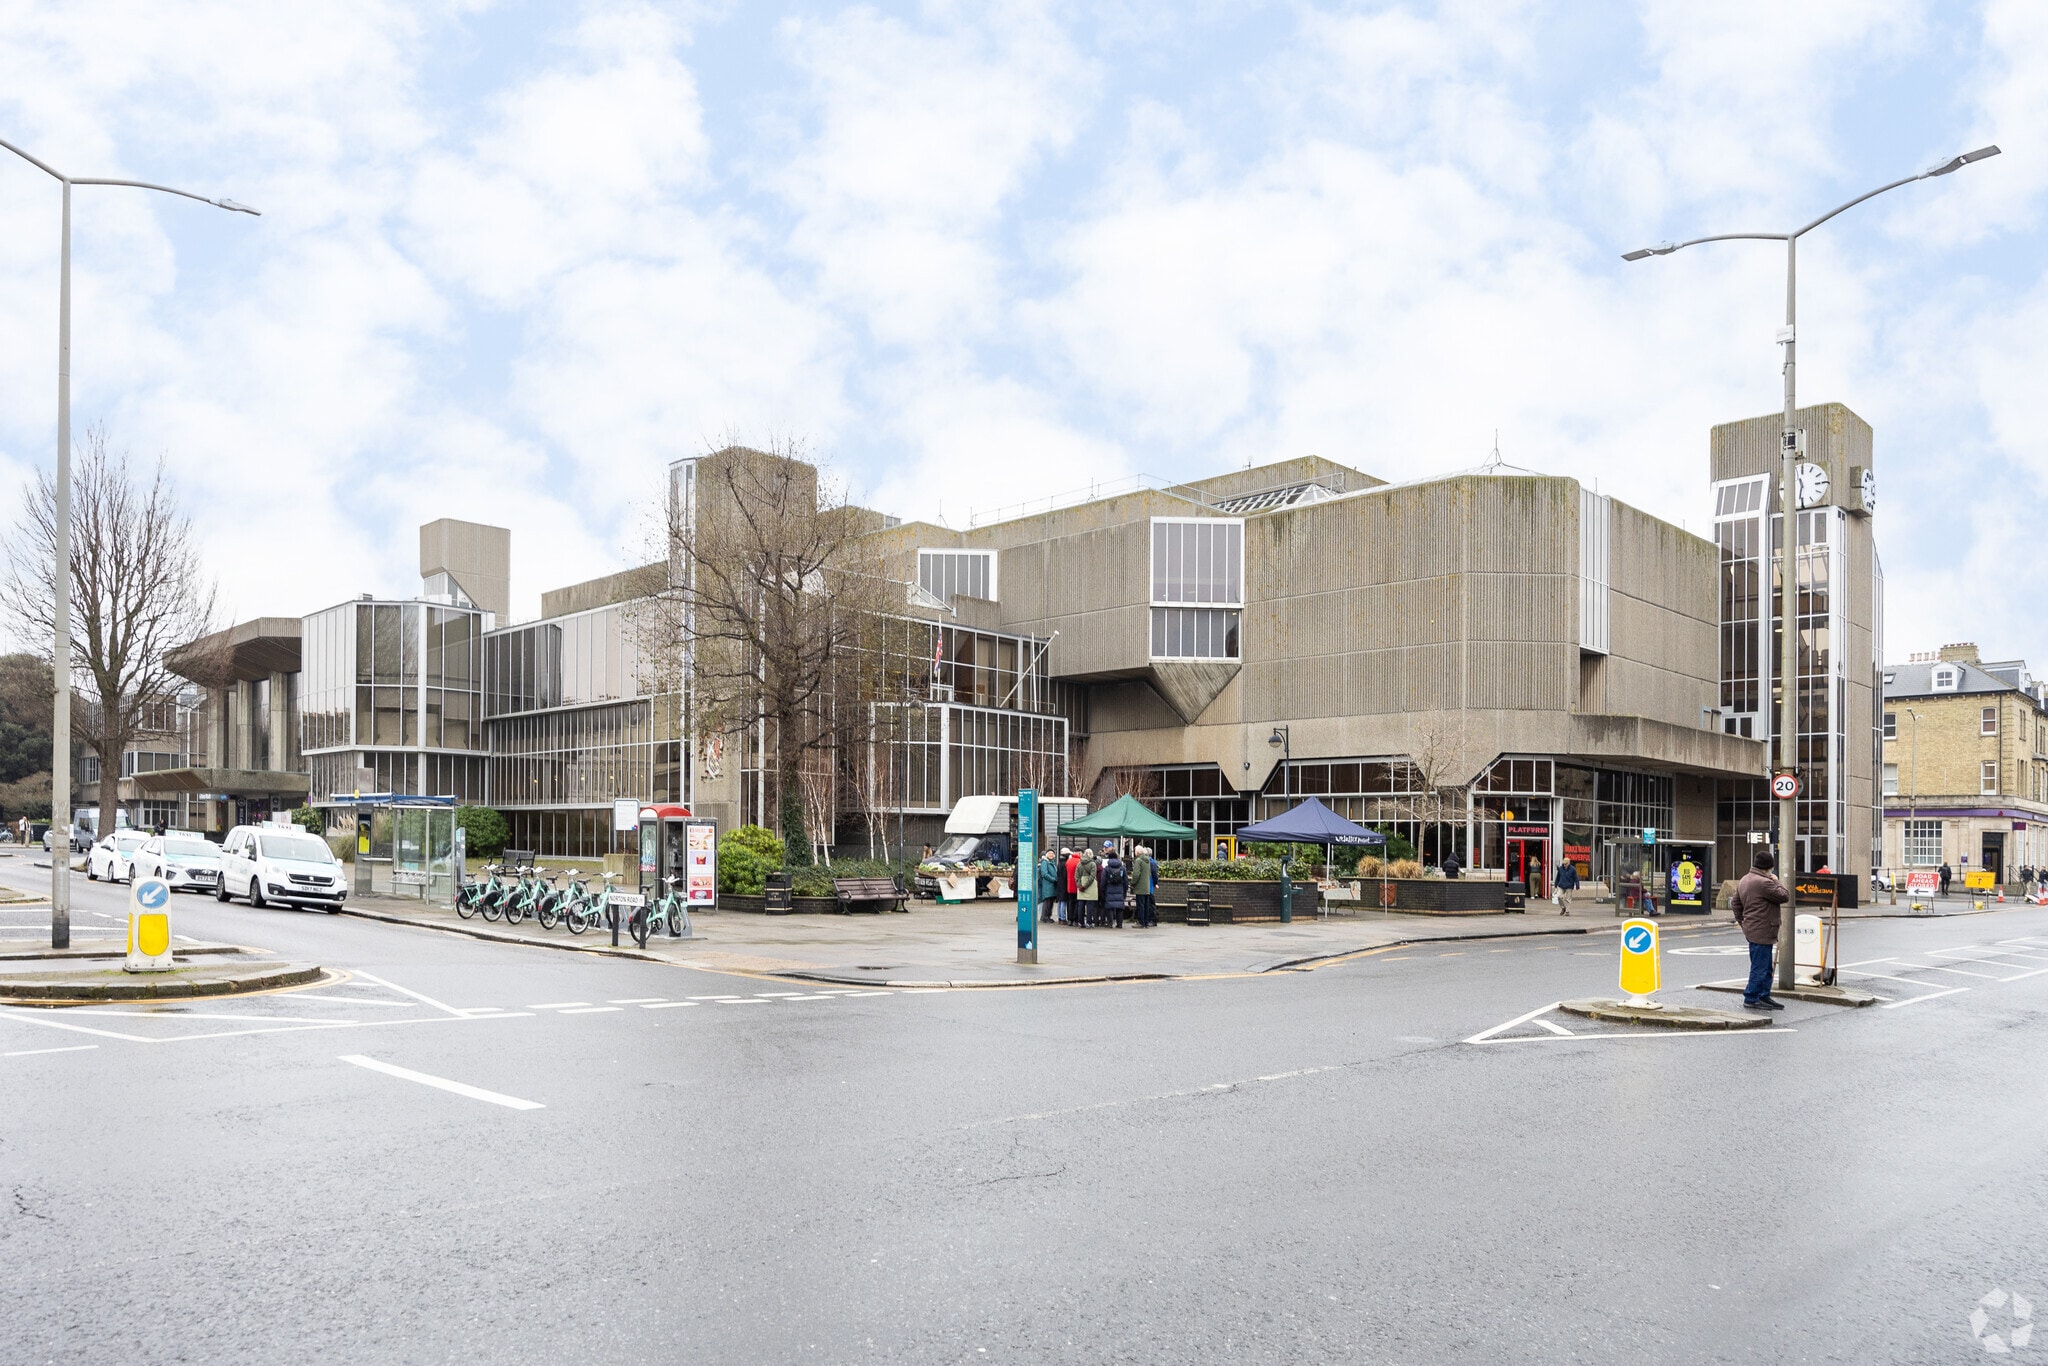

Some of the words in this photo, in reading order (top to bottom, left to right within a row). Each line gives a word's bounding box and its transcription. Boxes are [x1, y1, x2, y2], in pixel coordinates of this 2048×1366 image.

[1775, 781, 1794, 791] 20
[609, 895, 627, 903] NORTON
[627, 896, 639, 904] ROAD
